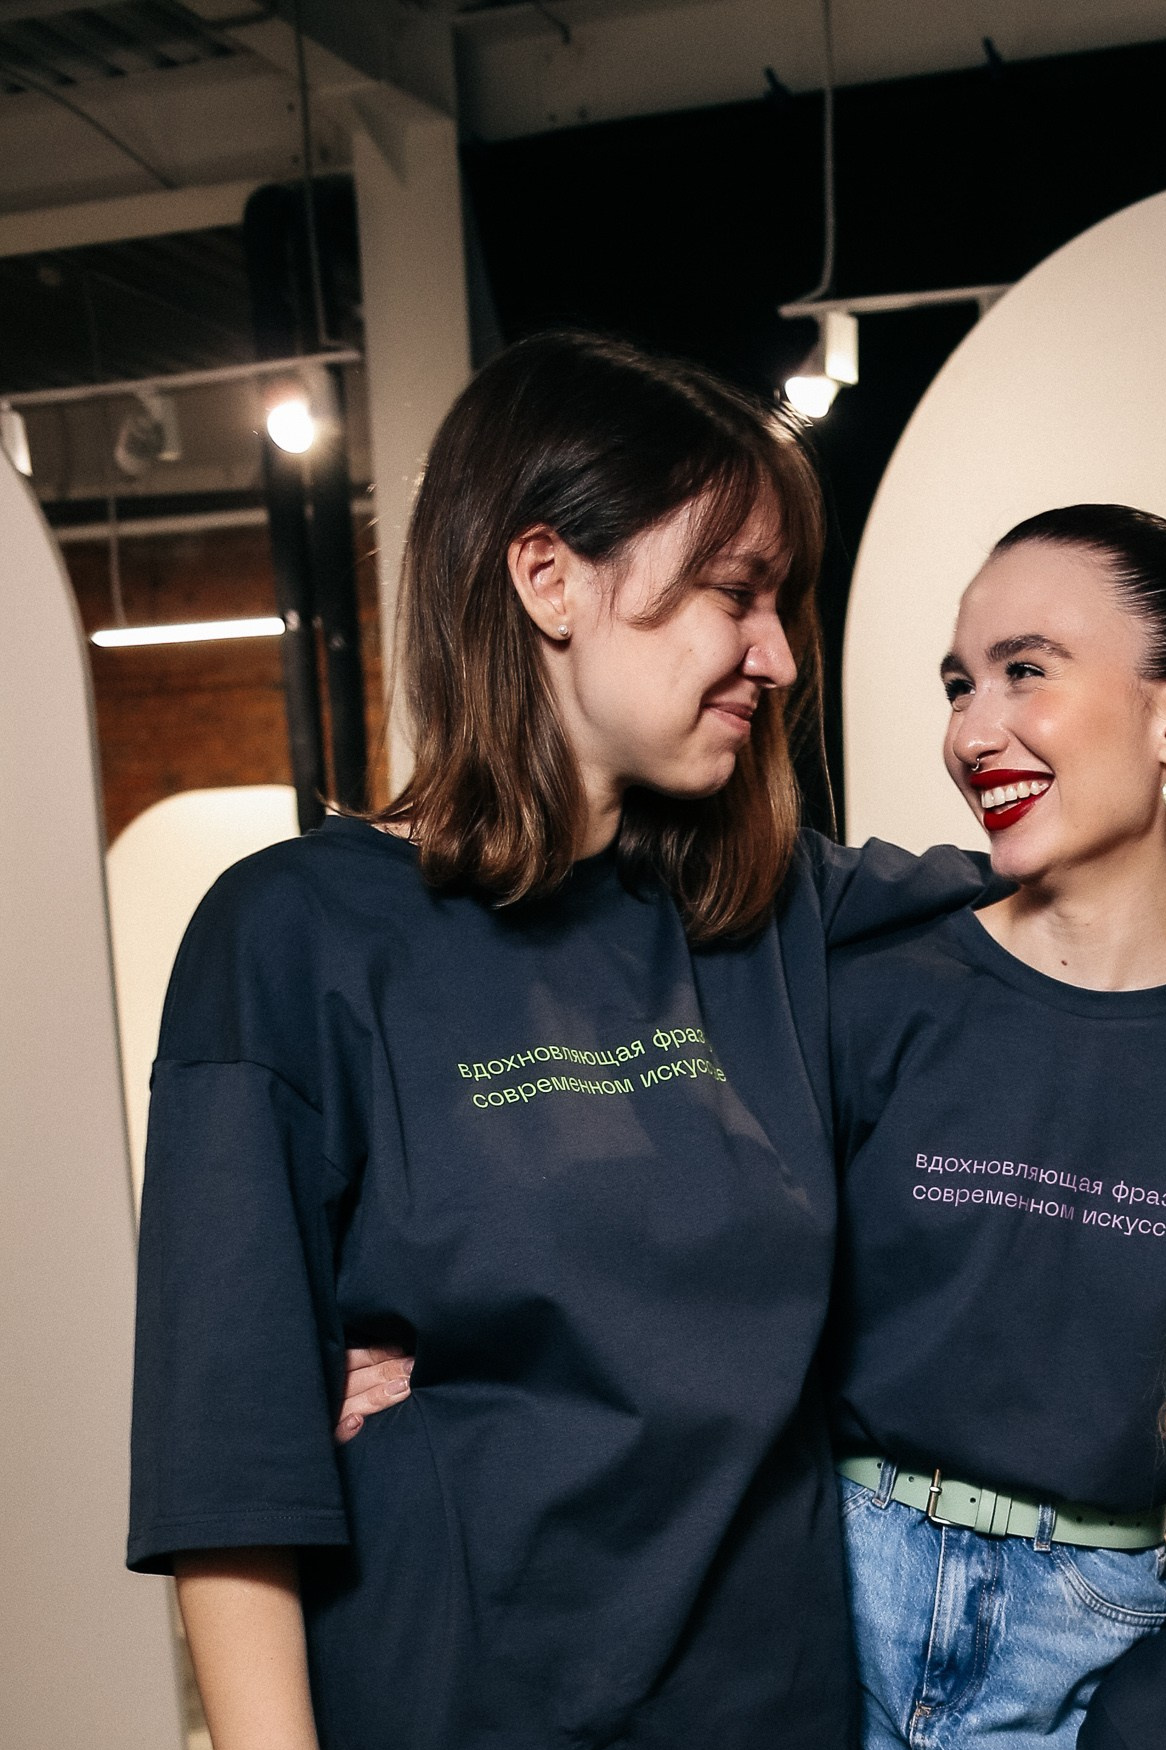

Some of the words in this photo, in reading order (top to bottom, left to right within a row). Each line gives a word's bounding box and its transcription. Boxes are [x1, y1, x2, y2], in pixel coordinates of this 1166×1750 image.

[457, 1040, 646, 1082] вдохновляющая
[652, 1027, 706, 1052] фраз
[472, 1076, 635, 1109] современном
[915, 1153, 1103, 1196] вдохновляющая
[912, 1184, 1074, 1221] современном
